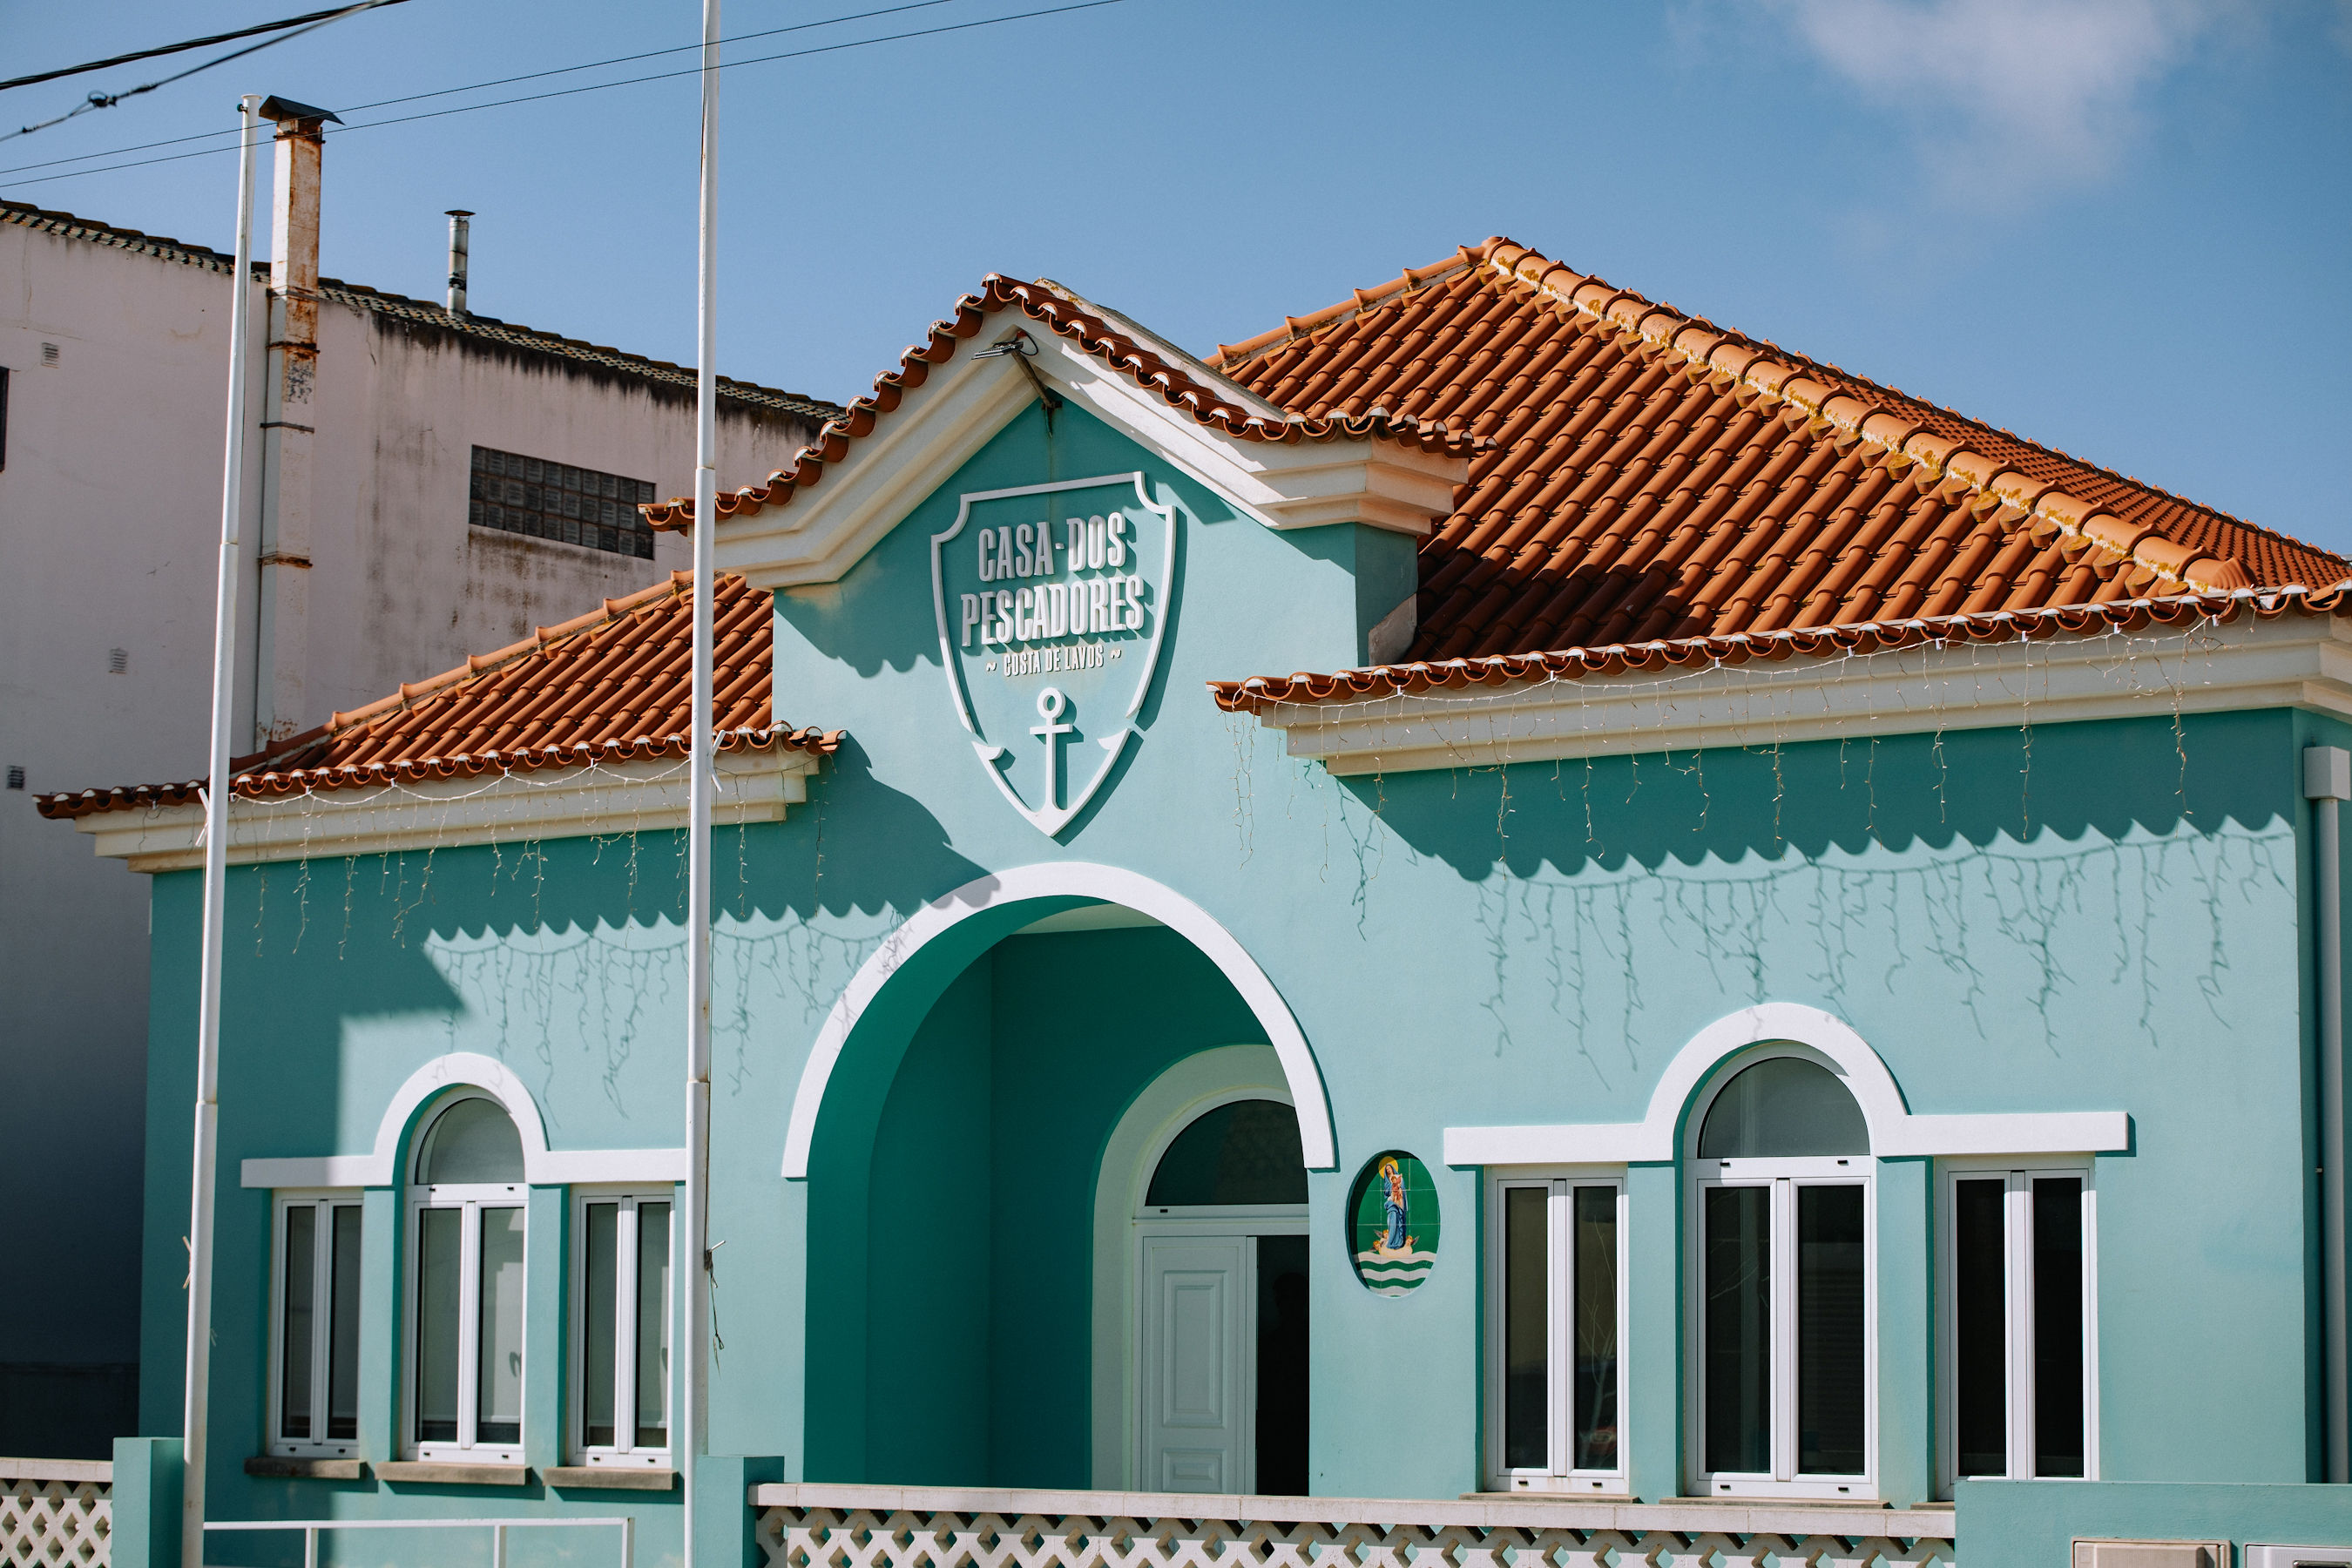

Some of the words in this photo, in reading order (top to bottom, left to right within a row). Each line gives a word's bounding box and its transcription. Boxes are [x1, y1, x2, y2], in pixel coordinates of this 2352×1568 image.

[960, 575, 1144, 647] PESCADORES
[1004, 650, 1041, 677] COSTA
[1045, 647, 1061, 672] DE
[1064, 644, 1104, 671] LAVOS
